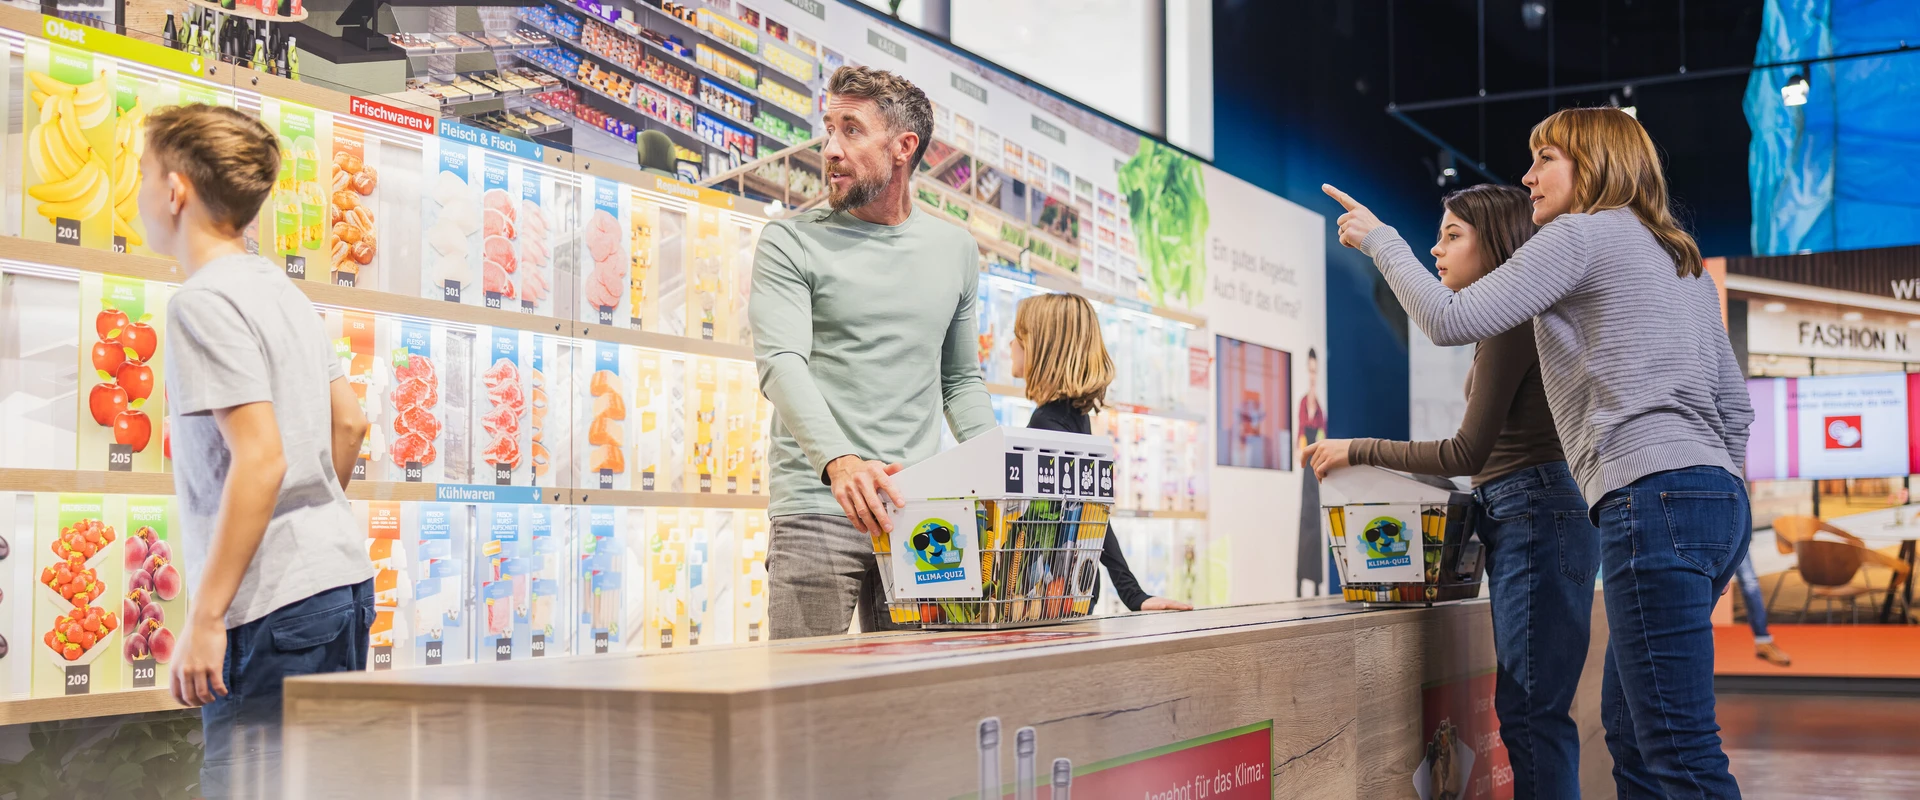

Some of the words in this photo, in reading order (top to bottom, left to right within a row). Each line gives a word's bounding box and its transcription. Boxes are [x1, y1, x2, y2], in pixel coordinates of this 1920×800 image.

[46, 20, 86, 44] Obst
[352, 99, 423, 129] Frischwaren
[440, 122, 477, 143] Fleisch
[480, 134, 488, 146] &
[491, 136, 517, 153] Fisch
[656, 178, 699, 199] Regalware
[57, 226, 79, 240] 201
[113, 243, 125, 254] 02
[1212, 237, 1228, 261] Ein
[1231, 248, 1257, 273] gutes
[287, 262, 304, 275] 204
[338, 278, 353, 288] 001
[1891, 278, 1920, 300] Wi
[445, 285, 460, 297] 301
[1212, 273, 1236, 300] Auch
[1240, 281, 1254, 306] für
[1256, 290, 1270, 312] das
[486, 297, 501, 308] 302
[600, 311, 613, 322] 304
[1798, 321, 1886, 350] FASHION
[335, 342, 350, 353] bio
[395, 352, 407, 362] bio
[110, 452, 131, 464] 205
[353, 465, 365, 475] 02
[406, 469, 421, 478] 305
[497, 470, 511, 480] 306
[1009, 466, 1020, 480] 22
[438, 486, 496, 501] Kühlwaren
[133, 511, 162, 521] FRÜCHTE
[1368, 557, 1409, 568] KLIMA-QUIZ
[916, 569, 965, 582] KLIMA-QUIZ
[497, 645, 511, 655] 402
[532, 641, 544, 650] 403
[375, 653, 390, 663] 003
[427, 648, 441, 658] 401
[134, 668, 154, 679] 210
[67, 674, 88, 686] 209
[1194, 774, 1211, 800] für
[1213, 769, 1232, 795] das
[1235, 762, 1265, 788] Klima:
